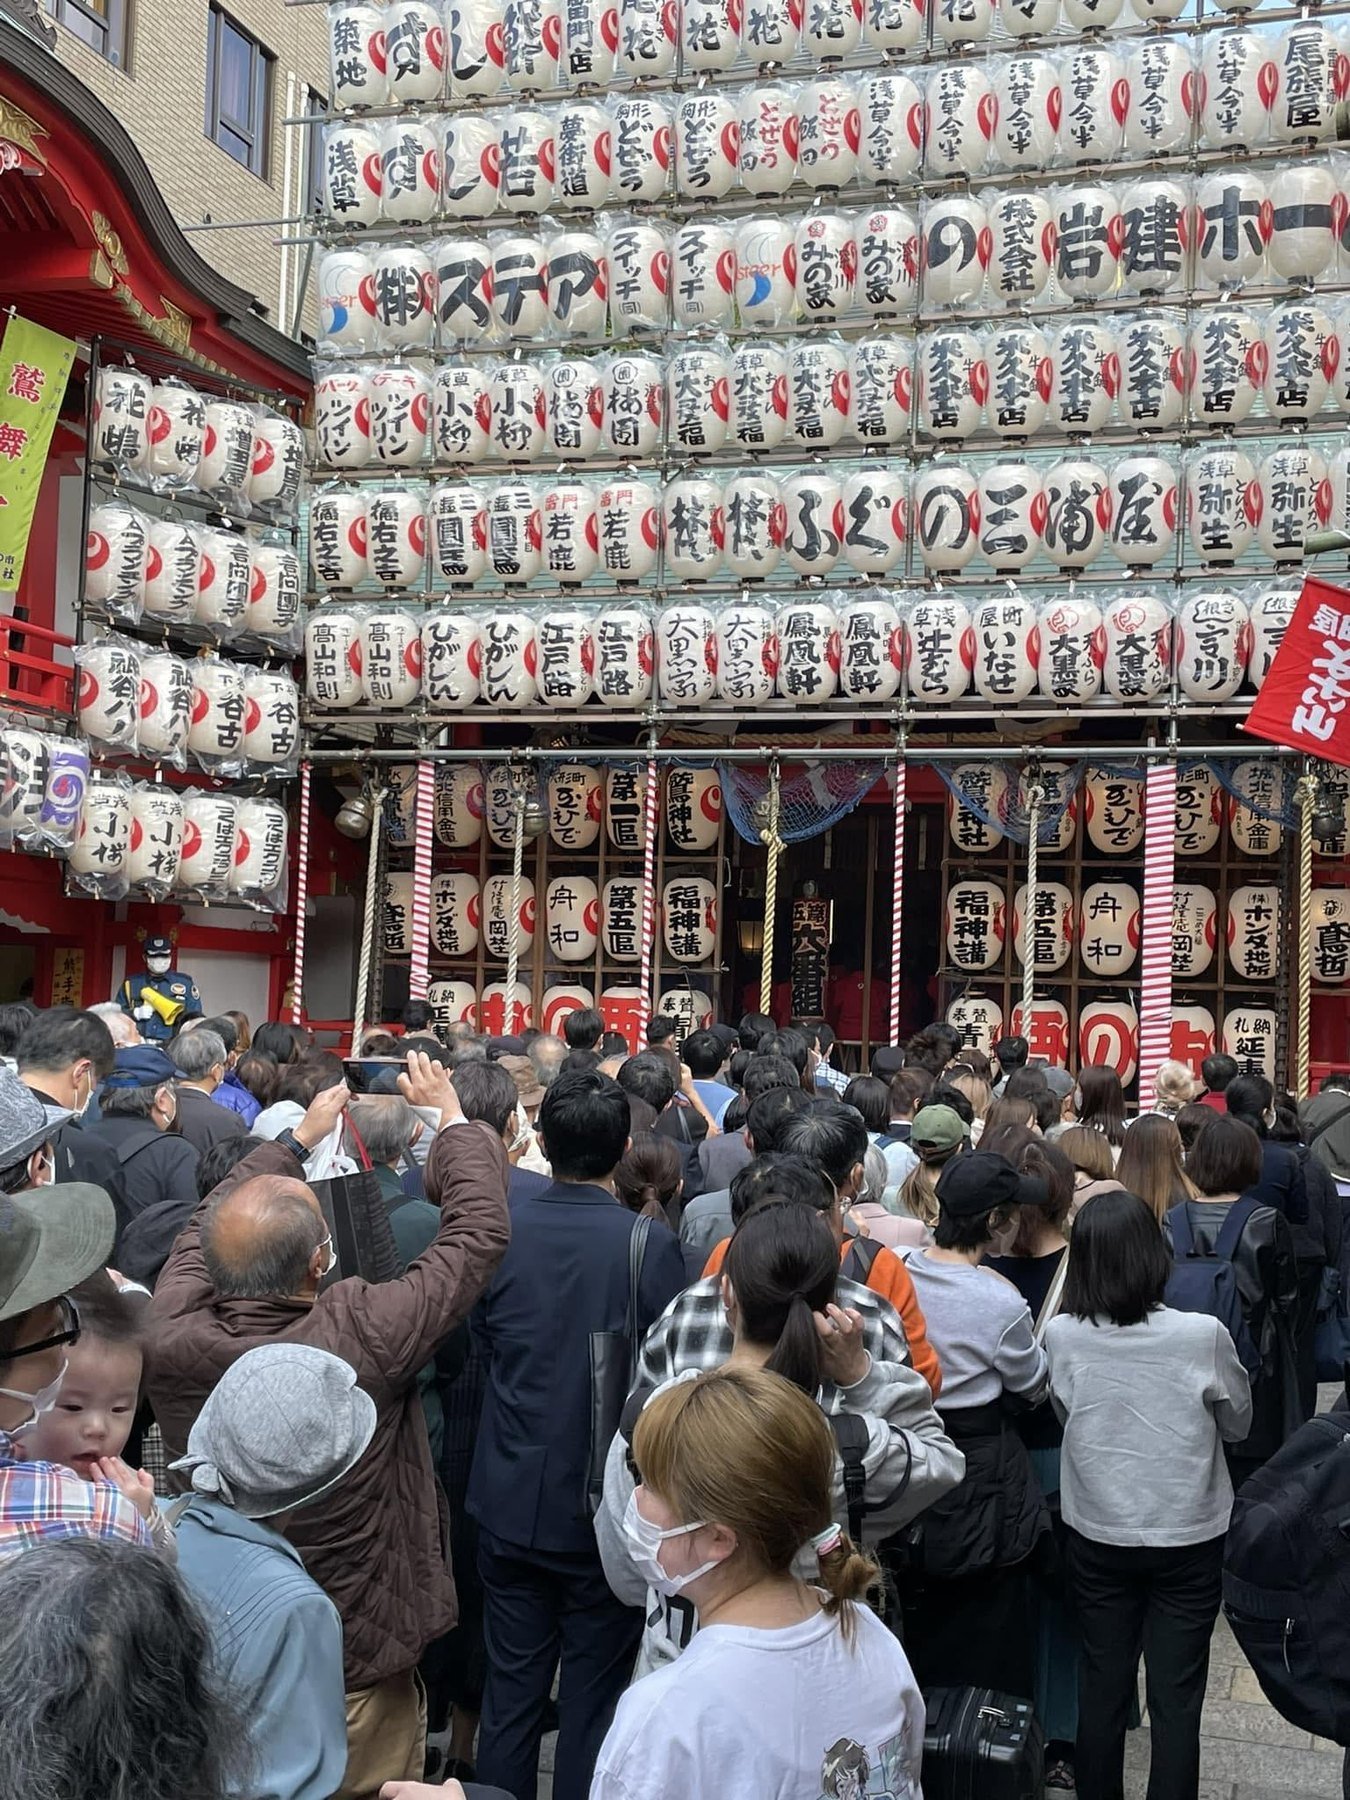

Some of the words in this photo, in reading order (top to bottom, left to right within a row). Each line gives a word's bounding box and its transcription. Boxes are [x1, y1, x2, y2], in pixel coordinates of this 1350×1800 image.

[334, 17, 367, 89] 築地
[1213, 36, 1247, 134] 浅草今半
[1284, 33, 1324, 128] 尾張屋
[616, 102, 651, 119] 駒形
[681, 101, 717, 120] 駒形
[868, 80, 895, 170] 浅草今半
[937, 69, 966, 162] 浅草今半
[1006, 61, 1035, 154] 浅草今半
[1069, 53, 1099, 148] 浅草今半
[1139, 46, 1169, 139] 浅草今半
[329, 140, 360, 213] 浅草
[559, 114, 589, 196] 夢街道
[616, 120, 653, 191] どぜう
[683, 118, 717, 188] どぜう
[801, 241, 835, 309] みの家
[861, 236, 896, 304] みの家
[927, 216, 977, 272] の
[999, 199, 1037, 291] 株式会社
[436, 391, 472, 453] 小柳
[493, 387, 532, 450] 小柳
[607, 387, 642, 446] 梅園
[1199, 459, 1234, 478] 浅草
[1272, 457, 1309, 477] 浅草
[921, 486, 970, 550] の
[1198, 483, 1233, 550] 弥生
[1271, 482, 1306, 549] 弥生
[429, 622, 460, 701] ひがしん
[485, 622, 519, 702] ひがしん
[541, 622, 576, 697] 江戸路
[598, 621, 633, 696] 江戸路
[784, 612, 821, 695] 鳳凰軒
[845, 612, 882, 693] 鳳凰軒
[984, 631, 1016, 694] いなせ
[550, 885, 579, 951] 舟和
[668, 885, 702, 956] 福神講
[953, 891, 989, 965] 福神講
[1088, 892, 1122, 965] 舟和
